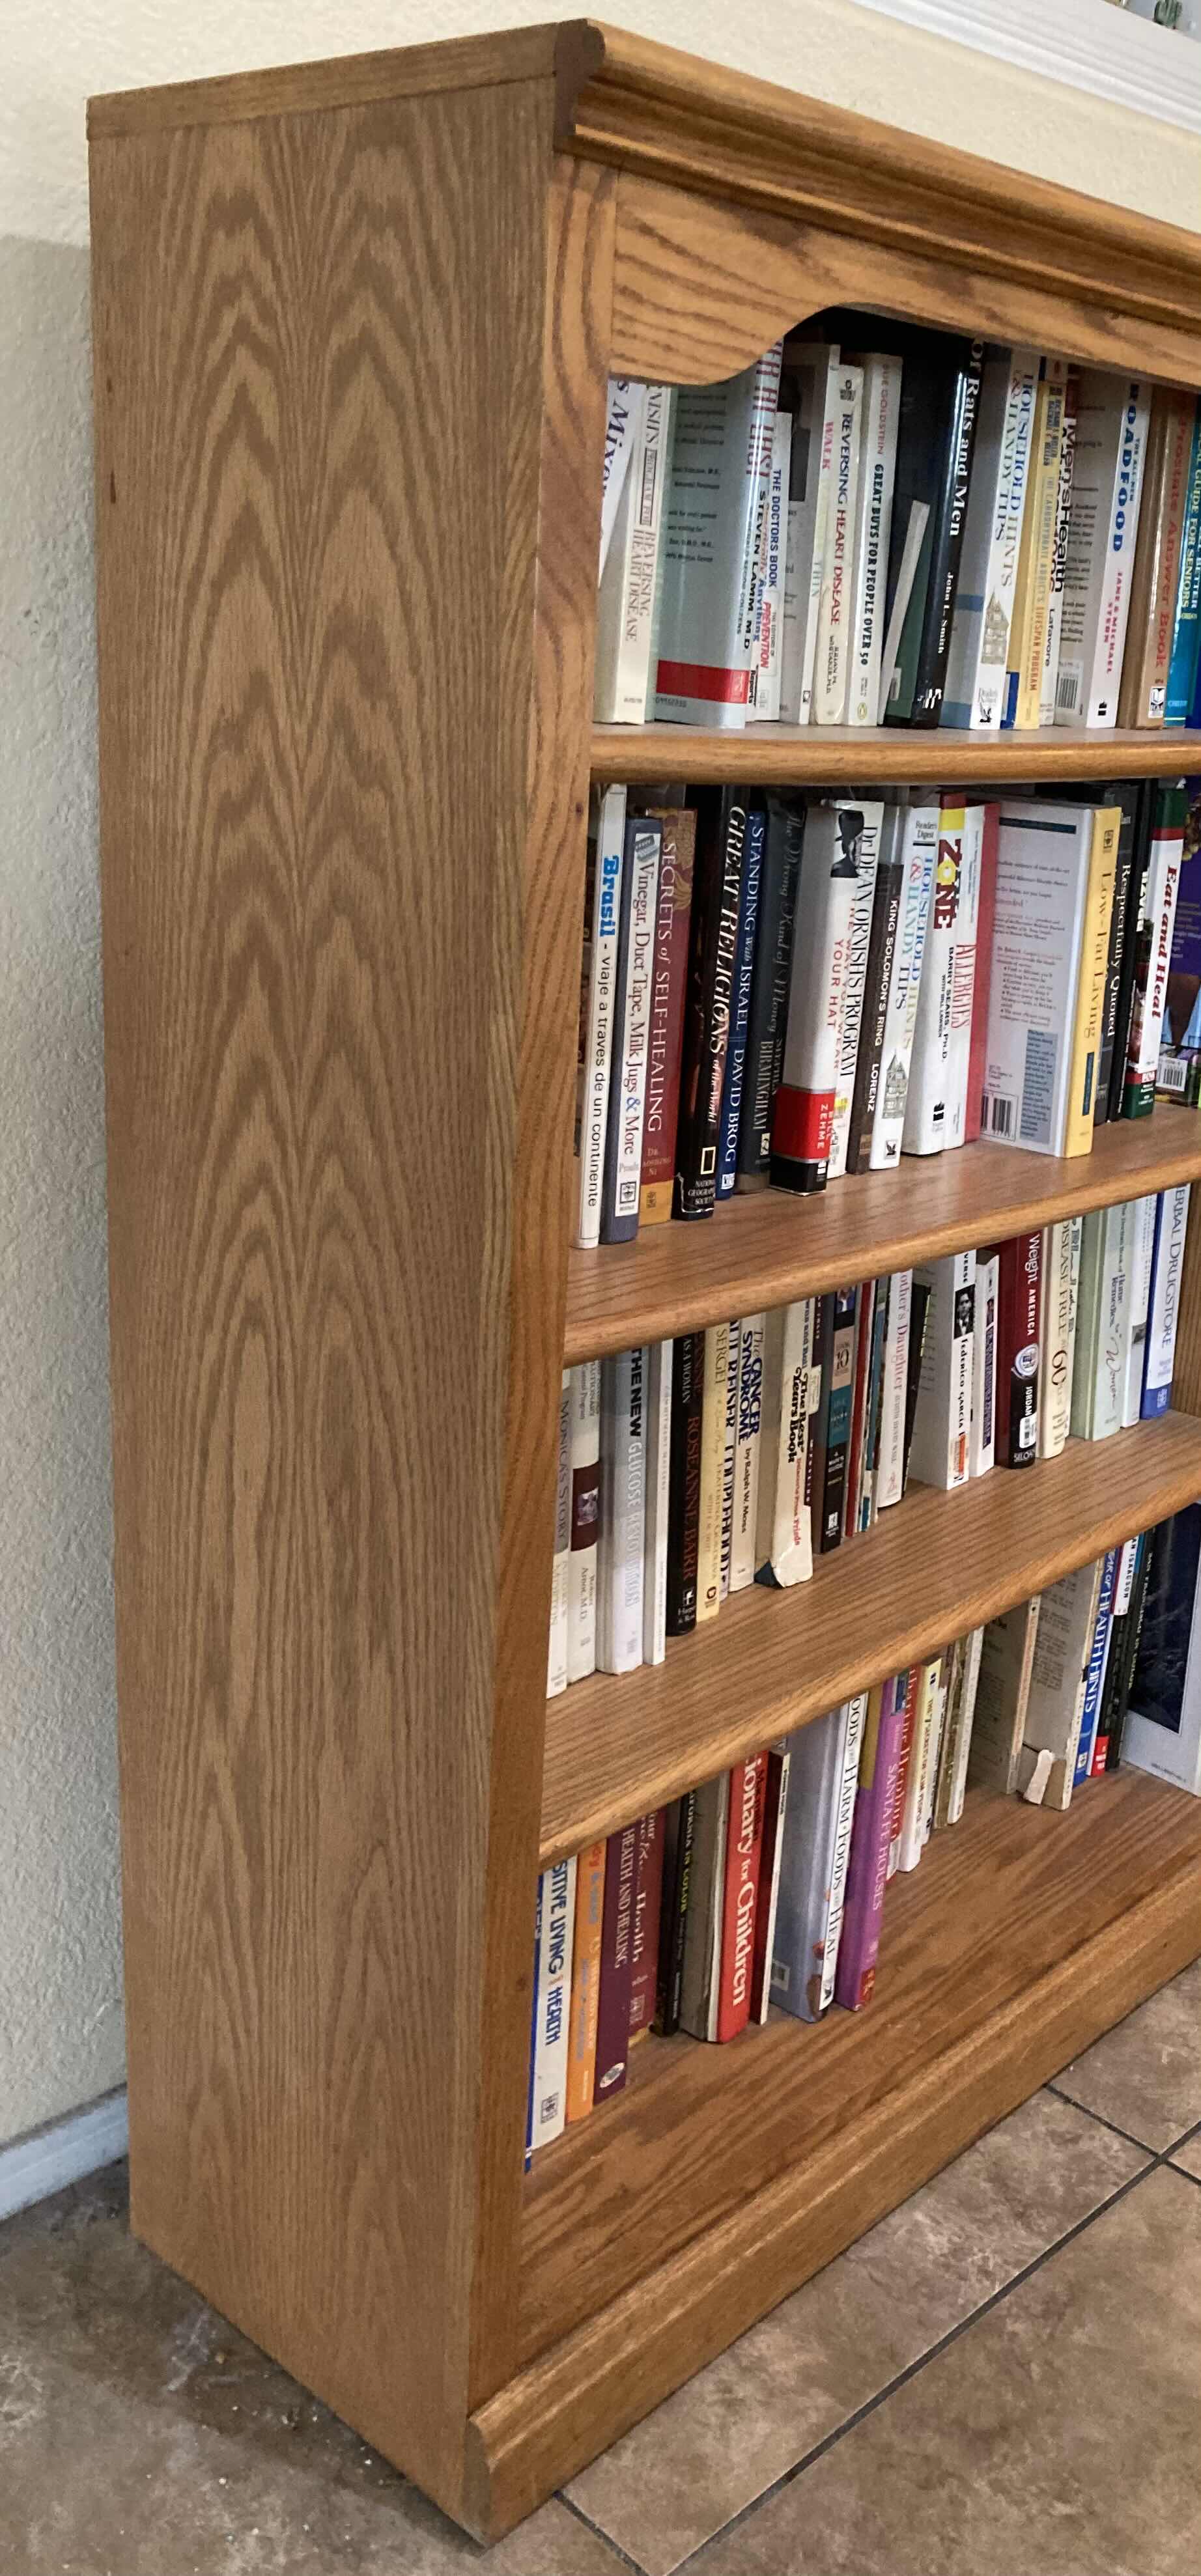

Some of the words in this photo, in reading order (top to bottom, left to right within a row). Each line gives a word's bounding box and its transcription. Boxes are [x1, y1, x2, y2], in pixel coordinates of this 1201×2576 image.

[877, 389, 889, 455] GOLDSTEIN
[963, 377, 980, 431] Rats
[822, 422, 834, 470] WALK
[838, 413, 854, 505] REVERSING
[956, 438, 970, 477] and
[1002, 403, 1020, 482] HANDY
[1010, 374, 1034, 511] HOUSEHOLD
[772, 469, 782, 492] THE
[872, 463, 884, 505] GREAT
[1191, 469, 1201, 513] GUIDE
[754, 490, 767, 555] STEVEN
[770, 496, 781, 552] DOCTORS
[833, 509, 847, 561] HEART
[869, 507, 881, 539] BUYS
[950, 485, 968, 537] Men
[995, 493, 1010, 542] TIPS
[1187, 517, 1198, 546] FOR
[629, 529, 645, 579] HEART
[638, 531, 657, 616] REVERSING
[769, 555, 780, 588] BOOK
[868, 541, 879, 566] FOR
[1002, 516, 1019, 587] HINTS
[1160, 521, 1179, 606] Answer
[830, 566, 843, 626] DISEASE
[864, 568, 876, 613] PEOPLE
[944, 572, 955, 601] John
[1181, 548, 1194, 609] SENIORS
[625, 581, 642, 641] DISEASE
[760, 602, 772, 668] PREVENTION
[860, 617, 873, 649] OVER
[937, 619, 949, 654] Smith
[1034, 604, 1044, 647] LIFESPAN
[859, 652, 869, 666] 50
[1045, 608, 1055, 667] Lafavore
[1106, 615, 1119, 674] MICHAEL
[1155, 610, 1173, 667] Book
[748, 670, 756, 704] Reports
[1029, 651, 1041, 691] PROGRAM
[722, 806, 746, 902] GREAT
[744, 826, 765, 932] STANDING
[852, 852, 877, 903] DEAN
[599, 854, 620, 938] Brasil
[633, 861, 655, 927] Vinegar,
[658, 841, 678, 941] SECRETS
[934, 838, 963, 930] ZONE
[1164, 865, 1178, 908] Eat
[776, 911, 793, 947] Kind
[887, 899, 899, 932] KING
[901, 884, 920, 956] HANDY
[912, 857, 935, 981] HOUSEHOLD
[1110, 863, 1132, 969] Respectfully
[1158, 913, 1170, 958] and
[634, 932, 651, 970] Duct
[658, 947, 671, 964] of
[742, 937, 754, 962] With
[830, 939, 845, 988] YOUR
[848, 908, 871, 989] ORNISH'S
[877, 936, 894, 1012] SOLOMON'S
[946, 946, 955, 985] BARRY
[597, 957, 612, 996] viaje
[629, 979, 649, 1016] Tape,
[708, 908, 740, 1056] RELIGIONS
[735, 965, 754, 1031] ISRAEL
[895, 966, 911, 1011] TIPS
[950, 944, 976, 1029] ALLERGIES
[599, 1002, 607, 1011] a
[767, 979, 787, 1033] Money
[827, 996, 839, 1028] HAT
[903, 986, 919, 1050] HINTS
[1083, 971, 1105, 1039] Living
[1107, 975, 1121, 1037] Quoted
[595, 1017, 610, 1067] traves
[628, 1022, 645, 1057] Milk
[647, 970, 671, 1132] SELF-HEALING
[840, 994, 863, 1078] PROGRAM
[874, 1016, 886, 1047] RING
[595, 1072, 607, 1092] de
[623, 1061, 641, 1093] Jugs
[729, 1049, 746, 1107] DAVID
[752, 1041, 774, 1130] BIRMINGHAM
[867, 1063, 881, 1113] LORENZ
[593, 1098, 602, 1118] un
[626, 1097, 642, 1112] &
[707, 1088, 719, 1123] World
[816, 1104, 829, 1149] ZEHME
[624, 1115, 640, 1155] More
[724, 1112, 741, 1162] BROG
[587, 1124, 602, 1207] continente
[1171, 1189, 1187, 1239] ERBAL
[1025, 1233, 1041, 1285] Weight
[1060, 1224, 1070, 1285] DISEASE
[897, 1274, 911, 1321] other's
[1026, 1289, 1038, 1337] AMERICA
[1057, 1289, 1069, 1336] FREE
[1109, 1276, 1120, 1328] Remedies
[1117, 1274, 1127, 1304] Home
[1161, 1242, 1182, 1351] DRUGSTORE
[682, 1354, 692, 1363] A
[683, 1337, 692, 1352] AS
[714, 1328, 729, 1386] SERGEI
[754, 1329, 764, 1356] The
[891, 1324, 909, 1391] Daughter
[959, 1339, 969, 1388] federico
[1051, 1349, 1069, 1386] 60
[629, 1347, 642, 1390] THE
[681, 1365, 692, 1404] WOMAN
[737, 1330, 754, 1445] SYNDROME
[791, 1367, 802, 1418] Years
[800, 1372, 809, 1407] The
[1106, 1336, 1122, 1409] Women
[629, 1392, 642, 1437] NEW
[748, 1356, 763, 1435] CANCER
[1024, 1386, 1034, 1417] JORDAN
[559, 1399, 571, 1480] MONICA'S
[743, 1448, 753, 1459] by
[787, 1420, 799, 1464] Book
[797, 1410, 809, 1453] Best
[628, 1442, 642, 1509] GLUCOSE
[742, 1461, 752, 1489] Ralph
[743, 1492, 750, 1504] W.
[556, 1487, 569, 1541] STORY
[1123, 1553, 1135, 1599] ISAACSON
[1092, 1590, 1112, 1659] HEALTH
[1084, 1662, 1100, 1714] HINTS
[847, 1697, 862, 1746] OODS
[737, 1759, 763, 1854] ionary
[839, 1764, 858, 1825] HARM
[882, 1763, 897, 1819] SANTA
[620, 1828, 636, 1881] HEALTH
[741, 1858, 751, 1881] for
[833, 1830, 851, 1891] FOODS
[871, 1845, 888, 1912] HOUSES
[550, 1860, 568, 1915] SITIVE
[618, 1883, 632, 1911] AND
[548, 1916, 567, 1975] LIVING
[614, 1912, 632, 1968] HEALING
[732, 1881, 755, 2006] Children
[826, 1907, 844, 1961] HEAL
[545, 1986, 563, 2047] HEALTH
